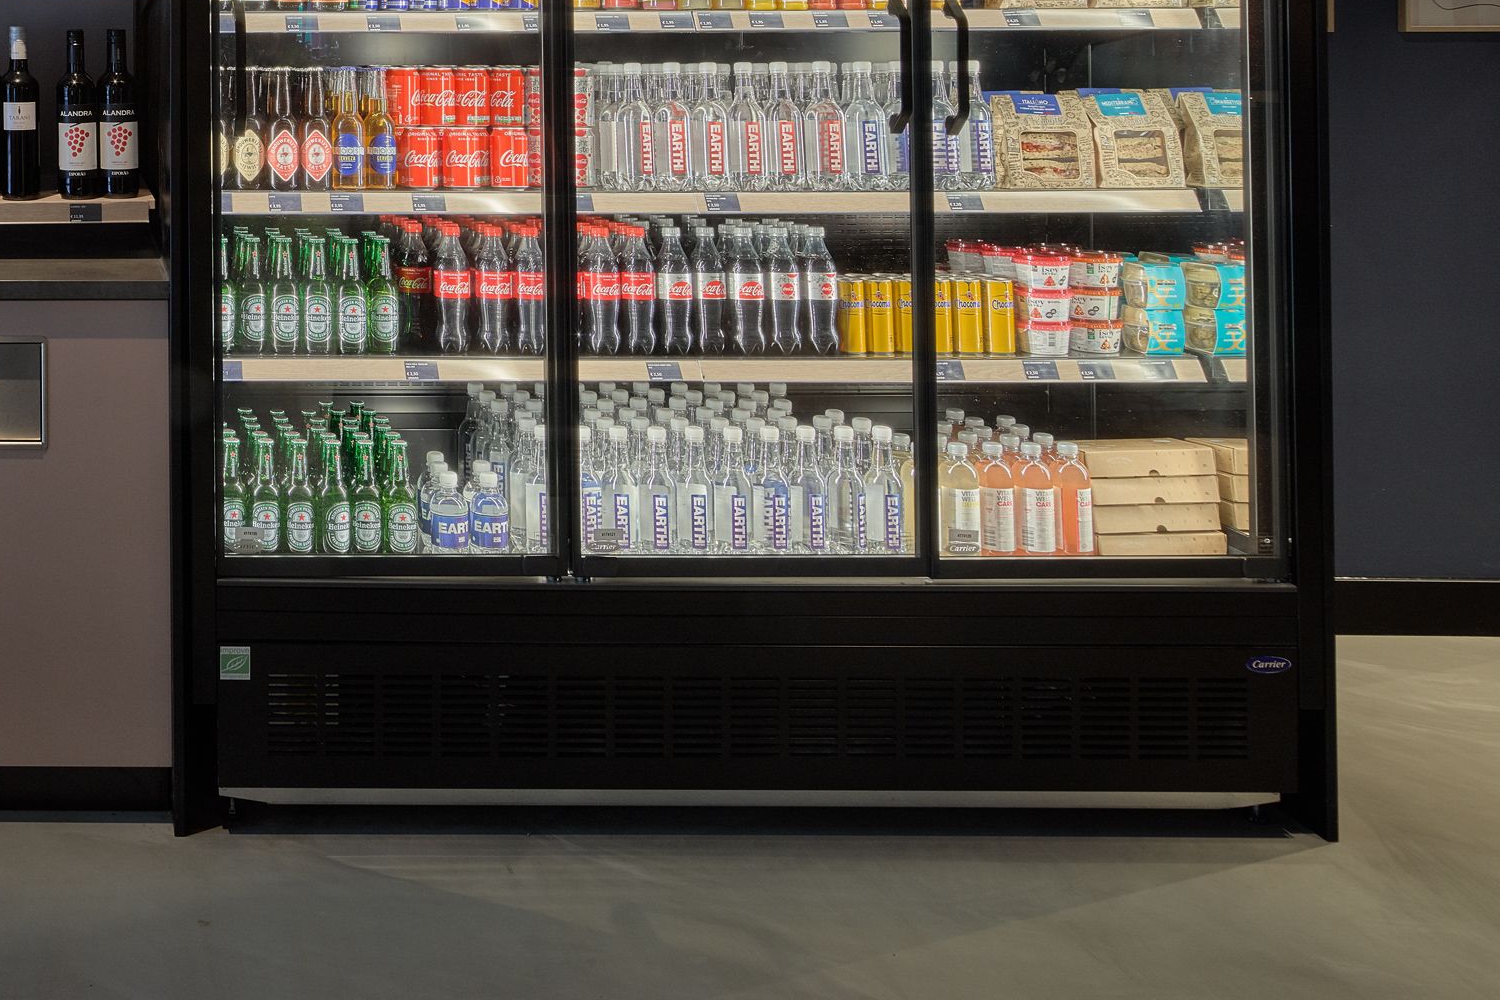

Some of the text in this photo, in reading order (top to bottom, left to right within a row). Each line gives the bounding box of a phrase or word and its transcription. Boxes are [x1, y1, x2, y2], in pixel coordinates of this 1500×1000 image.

[60, 109, 93, 117] ALANDRA
[103, 109, 135, 117] ALANDRA
[642, 123, 654, 173] EARTH
[671, 122, 684, 173] EARTH
[711, 122, 724, 173] EARTH
[748, 122, 760, 173] EARTH
[782, 122, 795, 173] EARTH
[828, 122, 842, 172] EARTH
[865, 123, 880, 172] EARTH
[977, 122, 992, 172] EARTH
[439, 281, 469, 295] Coca-Cola
[480, 281, 511, 295] Coca-Cola
[592, 282, 621, 296] Coca-Co
[621, 282, 654, 296] Coca-Cola
[587, 496, 597, 548] EARTH
[655, 496, 668, 548] EARTH
[693, 495, 706, 547] EARTH
[733, 496, 747, 548] EARTH
[775, 496, 788, 549] EARTH
[812, 495, 824, 548] EARTH
[887, 495, 900, 547] EARTH
[1253, 660, 1286, 668] Carrier
